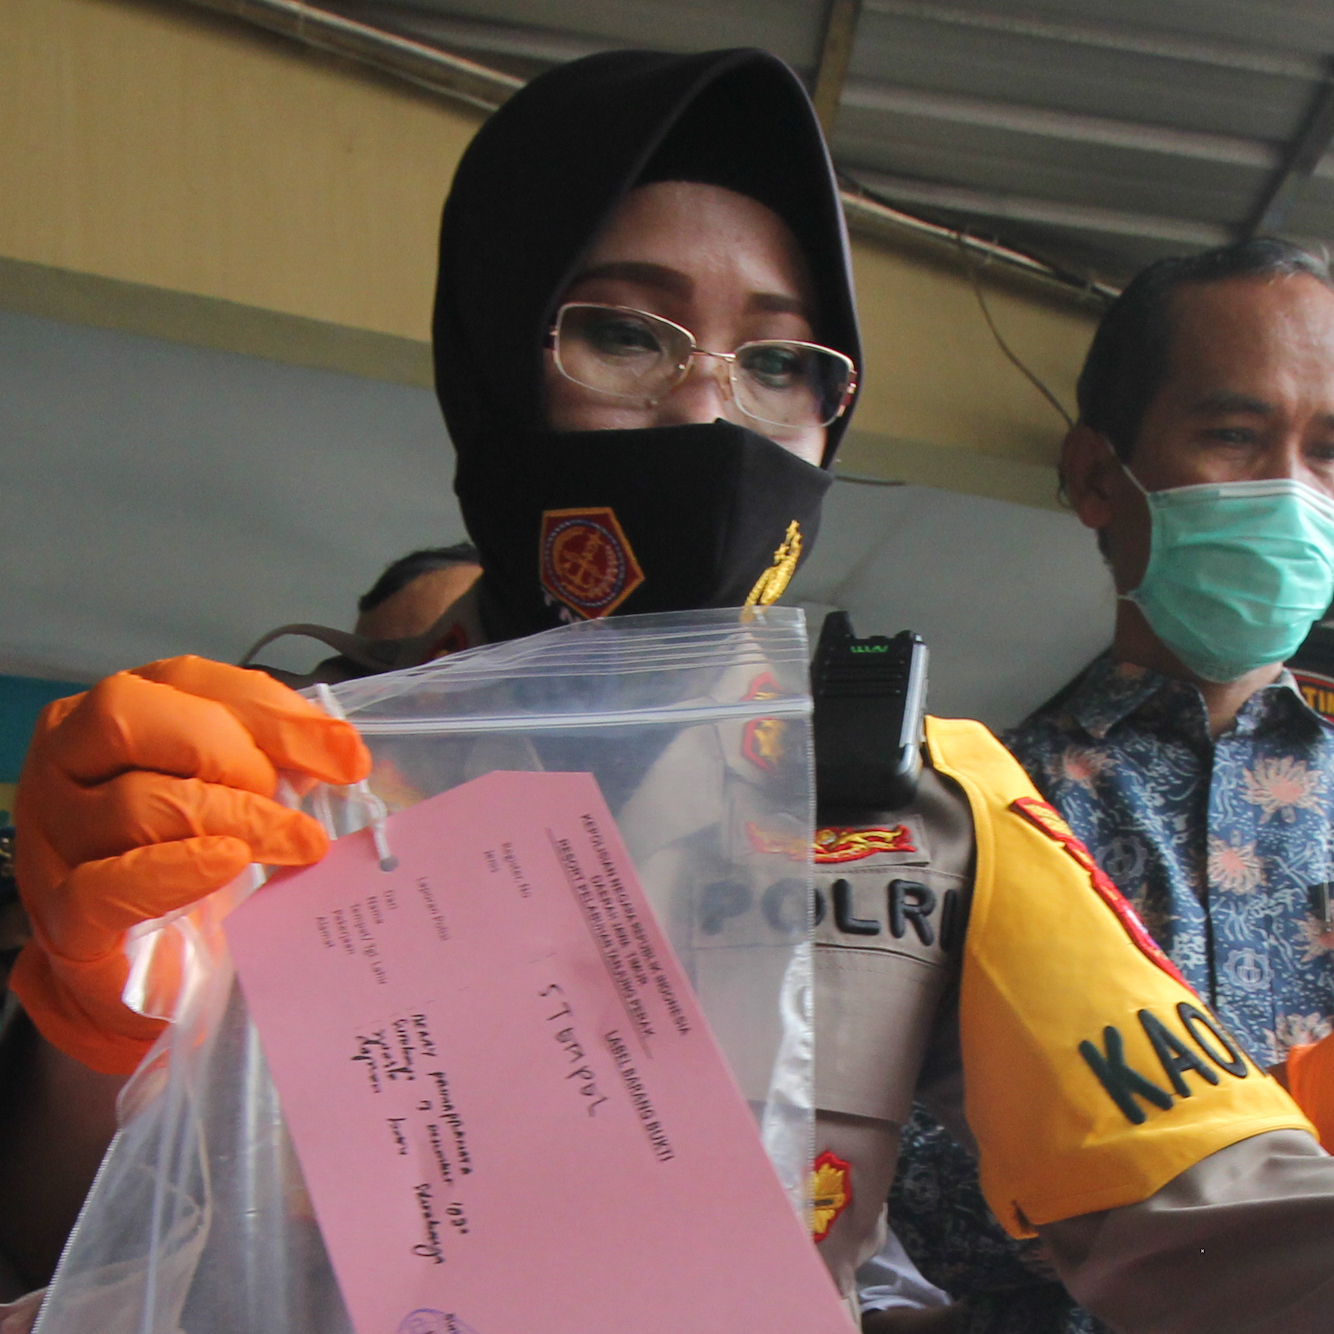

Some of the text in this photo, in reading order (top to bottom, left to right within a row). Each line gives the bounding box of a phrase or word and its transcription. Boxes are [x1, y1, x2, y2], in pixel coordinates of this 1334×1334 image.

[609, 877, 637, 922] NEGARA
[698, 876, 965, 952] POLRI
[603, 1029, 675, 1163] LABEL BARANG BUKTI
[1078, 1001, 1248, 1125] KAO
